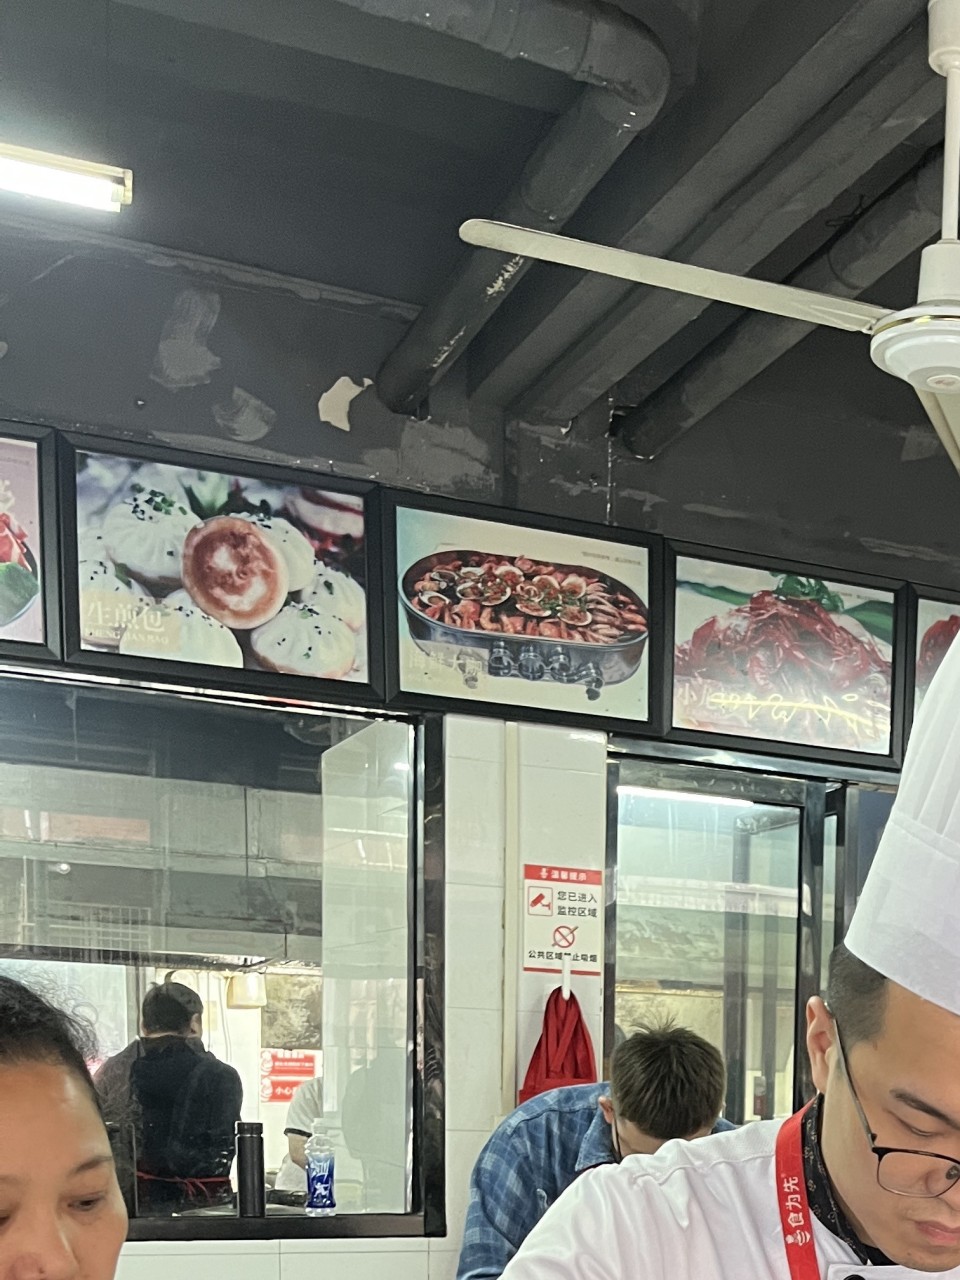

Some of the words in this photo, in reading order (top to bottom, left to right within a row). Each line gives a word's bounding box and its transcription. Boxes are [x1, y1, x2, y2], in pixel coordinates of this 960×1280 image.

[88, 601, 164, 632] 生煎包
[557, 890, 598, 904] 您已进入
[557, 906, 598, 918] 监控区域
[783, 1176, 805, 1228] 食为先
